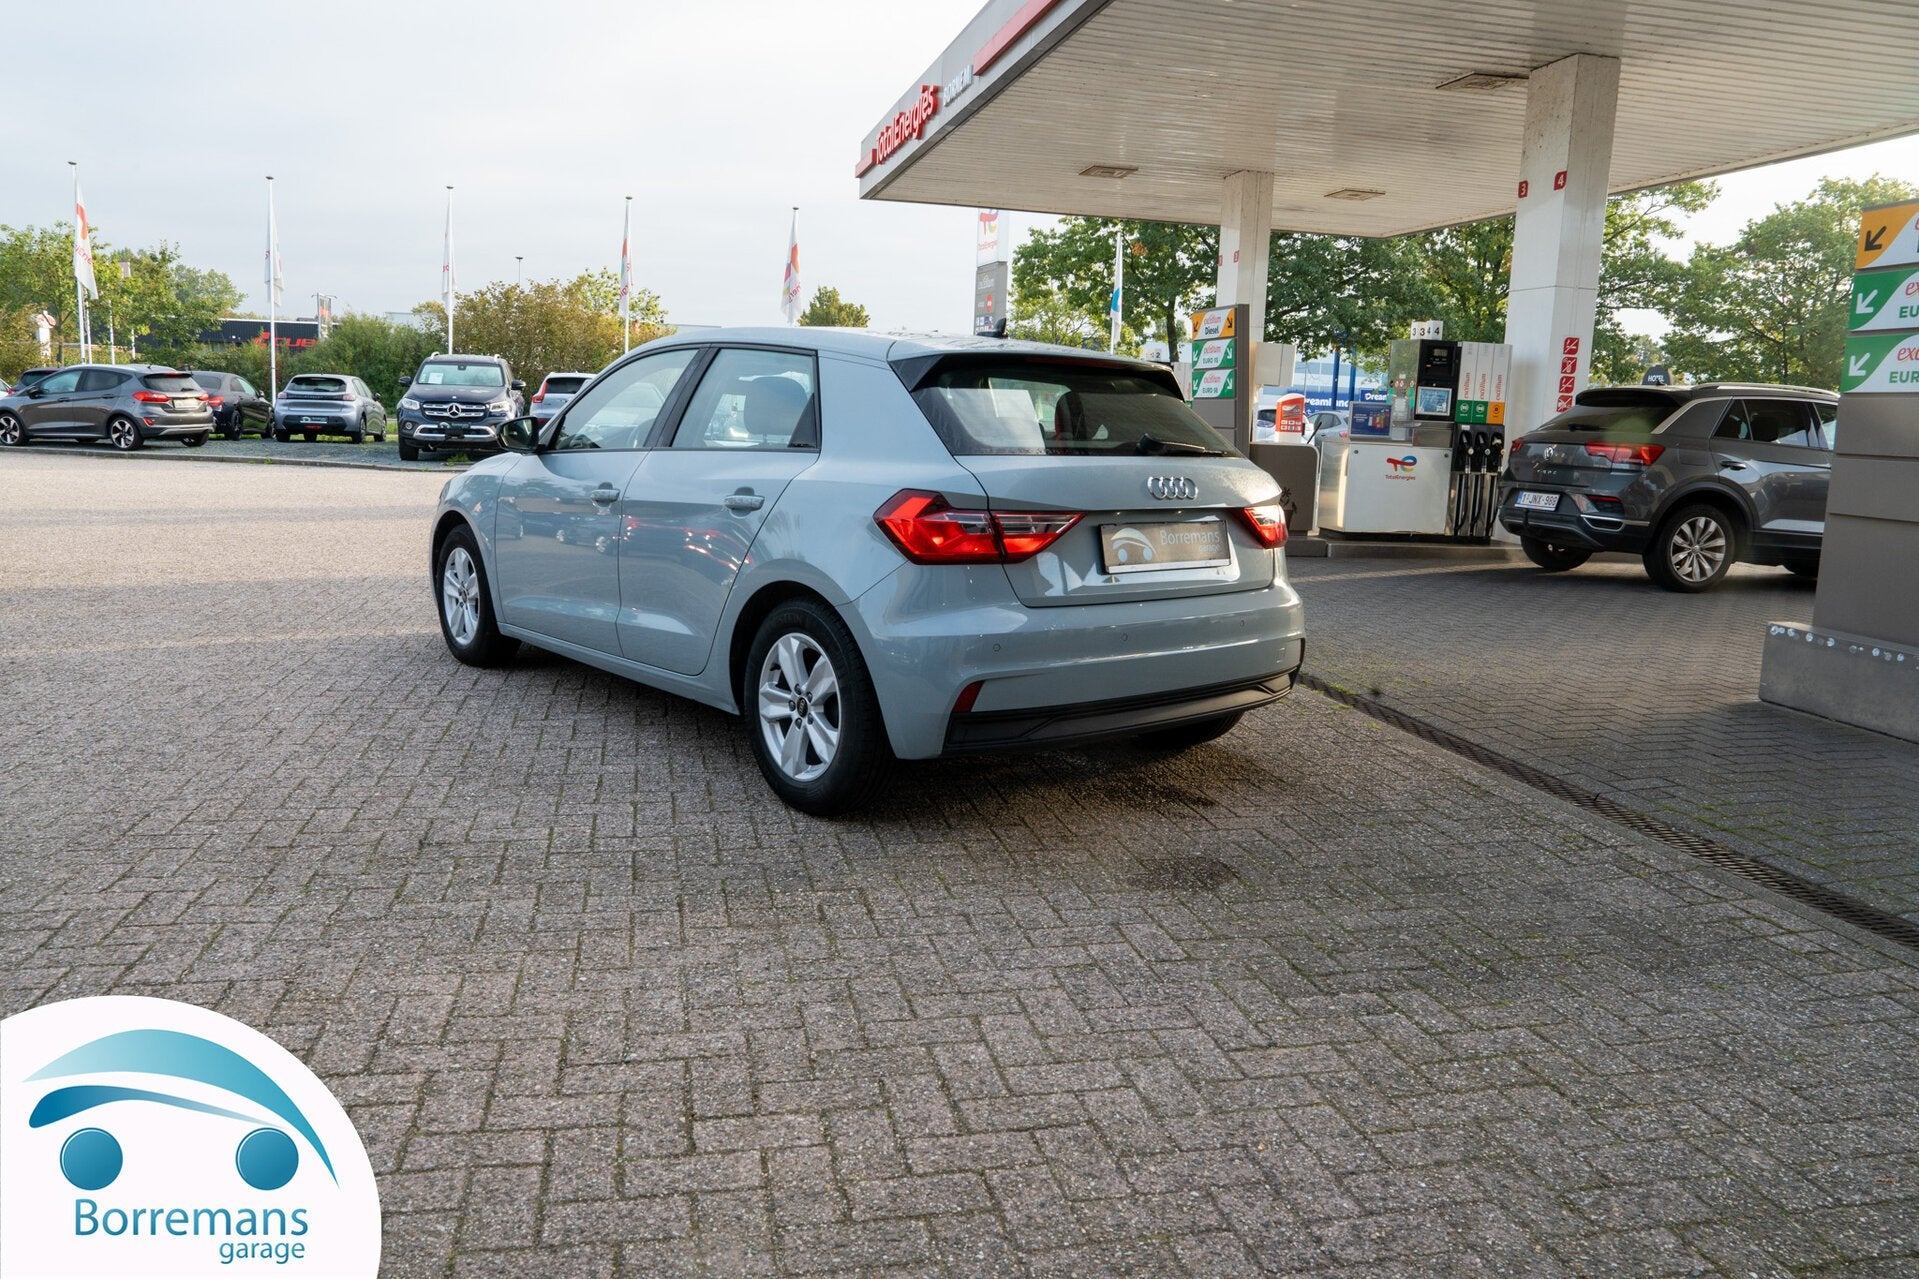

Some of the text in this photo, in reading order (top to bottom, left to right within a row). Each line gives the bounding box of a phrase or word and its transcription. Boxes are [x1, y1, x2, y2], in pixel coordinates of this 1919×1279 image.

[876, 84, 939, 164] TotalEnergies
[1558, 174, 1564, 186] 4
[1520, 183, 1527, 196] 3
[1205, 325, 1220, 335] Diesel
[1160, 529, 1220, 545] Borremans
